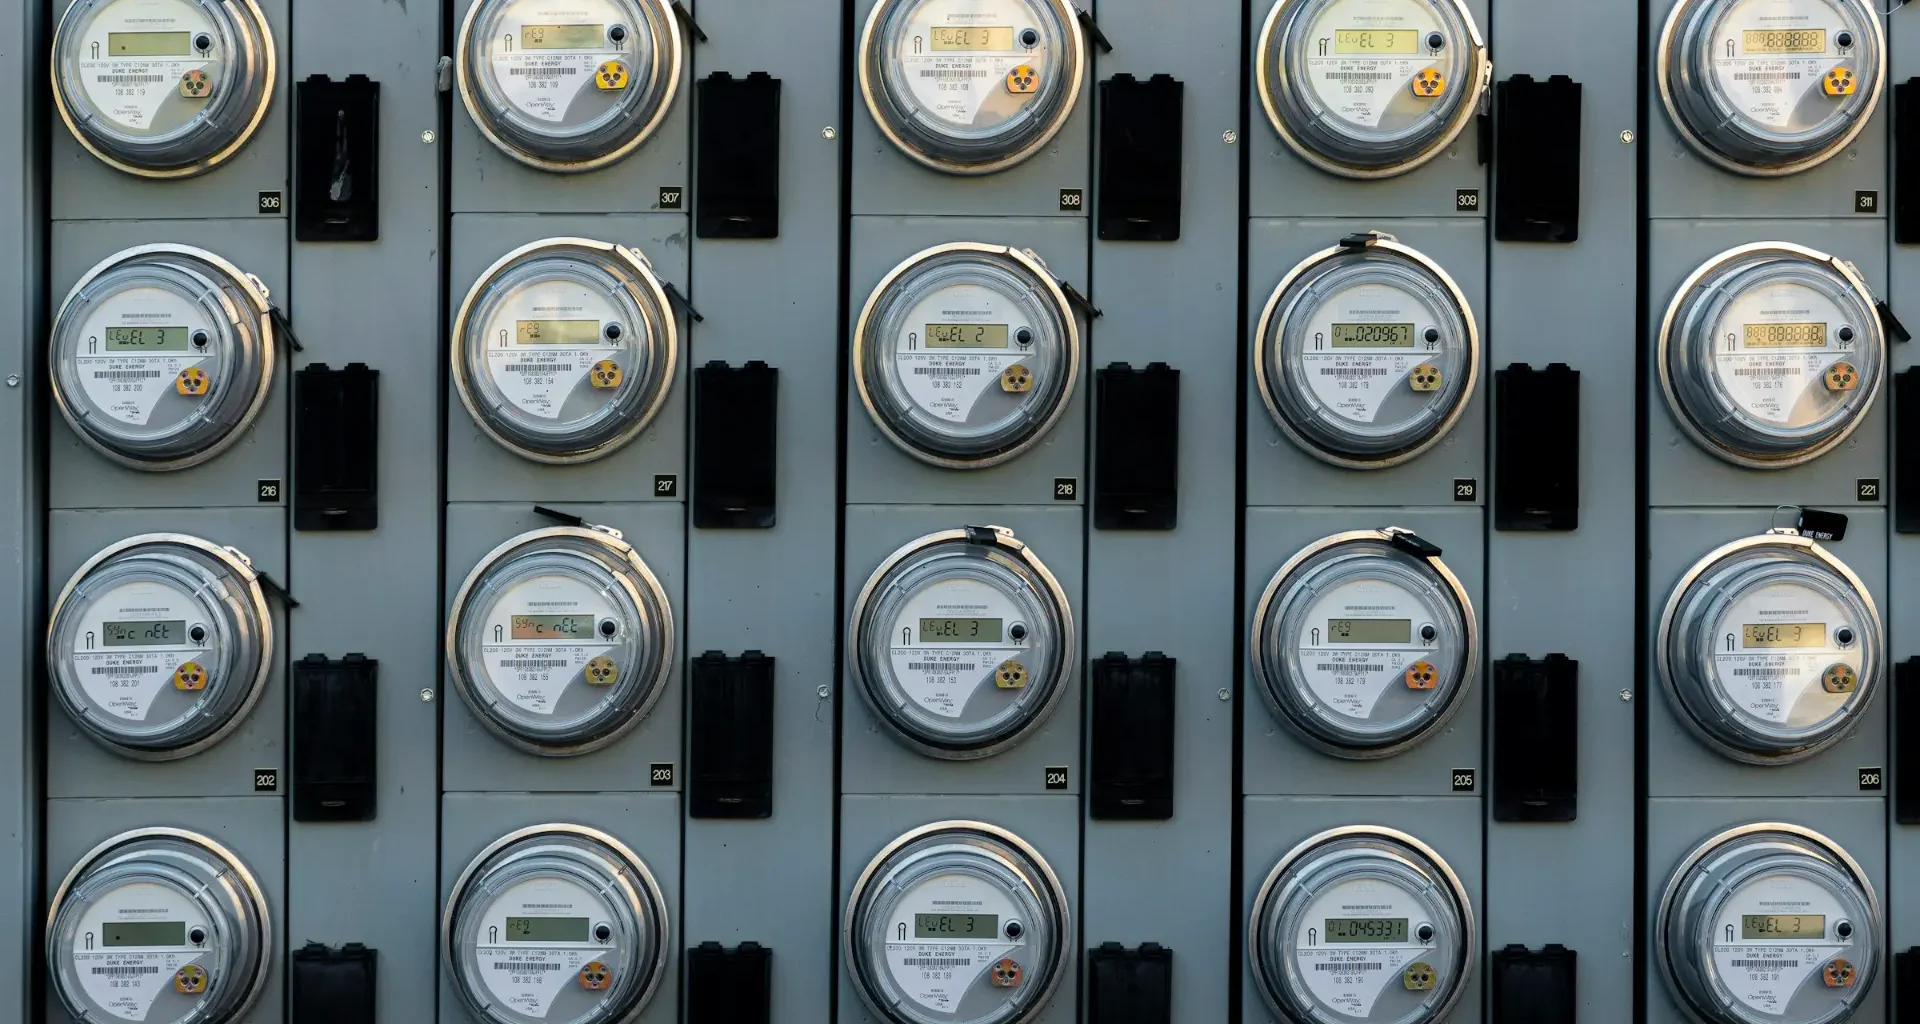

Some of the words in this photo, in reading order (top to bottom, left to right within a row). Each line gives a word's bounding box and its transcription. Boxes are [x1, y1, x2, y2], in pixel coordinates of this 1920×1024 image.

[261, 197, 279, 207] 306
[662, 193, 679, 203] 307
[1062, 195, 1080, 205] 308
[1458, 195, 1476, 205] 309
[1860, 197, 1872, 207] 311
[261, 486, 276, 496] 216
[658, 481, 672, 491] 217
[1058, 484, 1073, 494] 218
[1458, 485, 1472, 495] 219
[1861, 485, 1875, 495] 221
[1802, 530, 1814, 538] DUKE
[1815, 532, 1833, 540] ENERGY
[257, 775, 274, 785] 202
[653, 770, 670, 780] 203
[1048, 773, 1065, 783] 204
[1455, 775, 1472, 785] 205
[1861, 774, 1879, 784] 206
[1350, 921, 1401, 936] 045331
